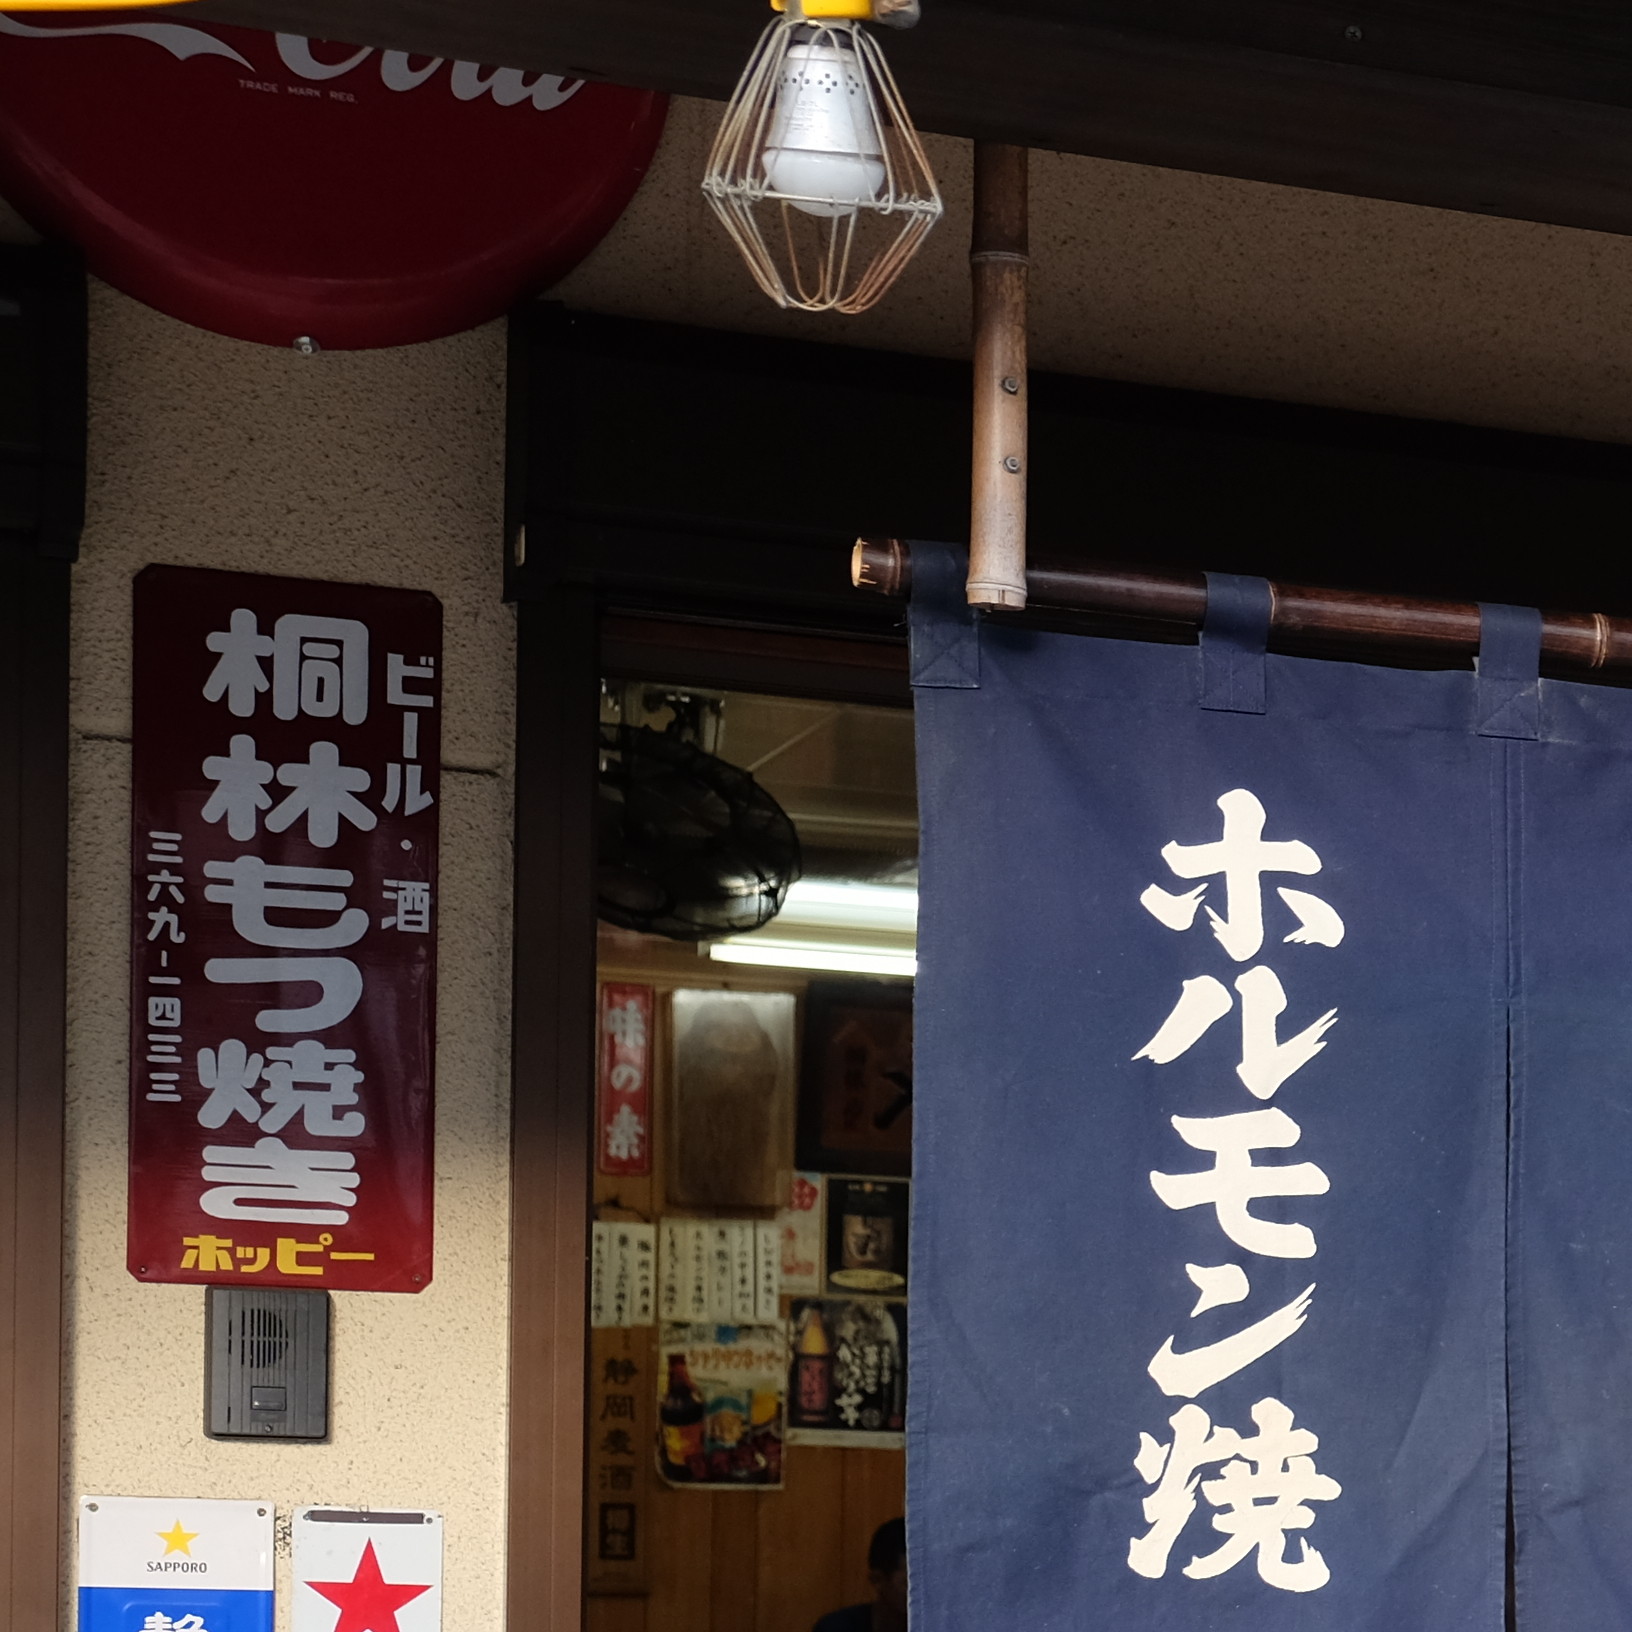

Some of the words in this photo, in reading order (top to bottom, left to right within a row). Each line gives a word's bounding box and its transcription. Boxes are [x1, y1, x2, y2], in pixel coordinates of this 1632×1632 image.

[237, 79, 279, 94] TRADE
[286, 85, 322, 99] MARK
[381, 652, 434, 934] ビール・酒
[197, 607, 377, 1225] 桐林もつ焼き
[180, 1232, 375, 1275] ホッピー
[1127, 787, 1346, 1593] ホルモン焼
[146, 1561, 208, 1574] SAPPORO
